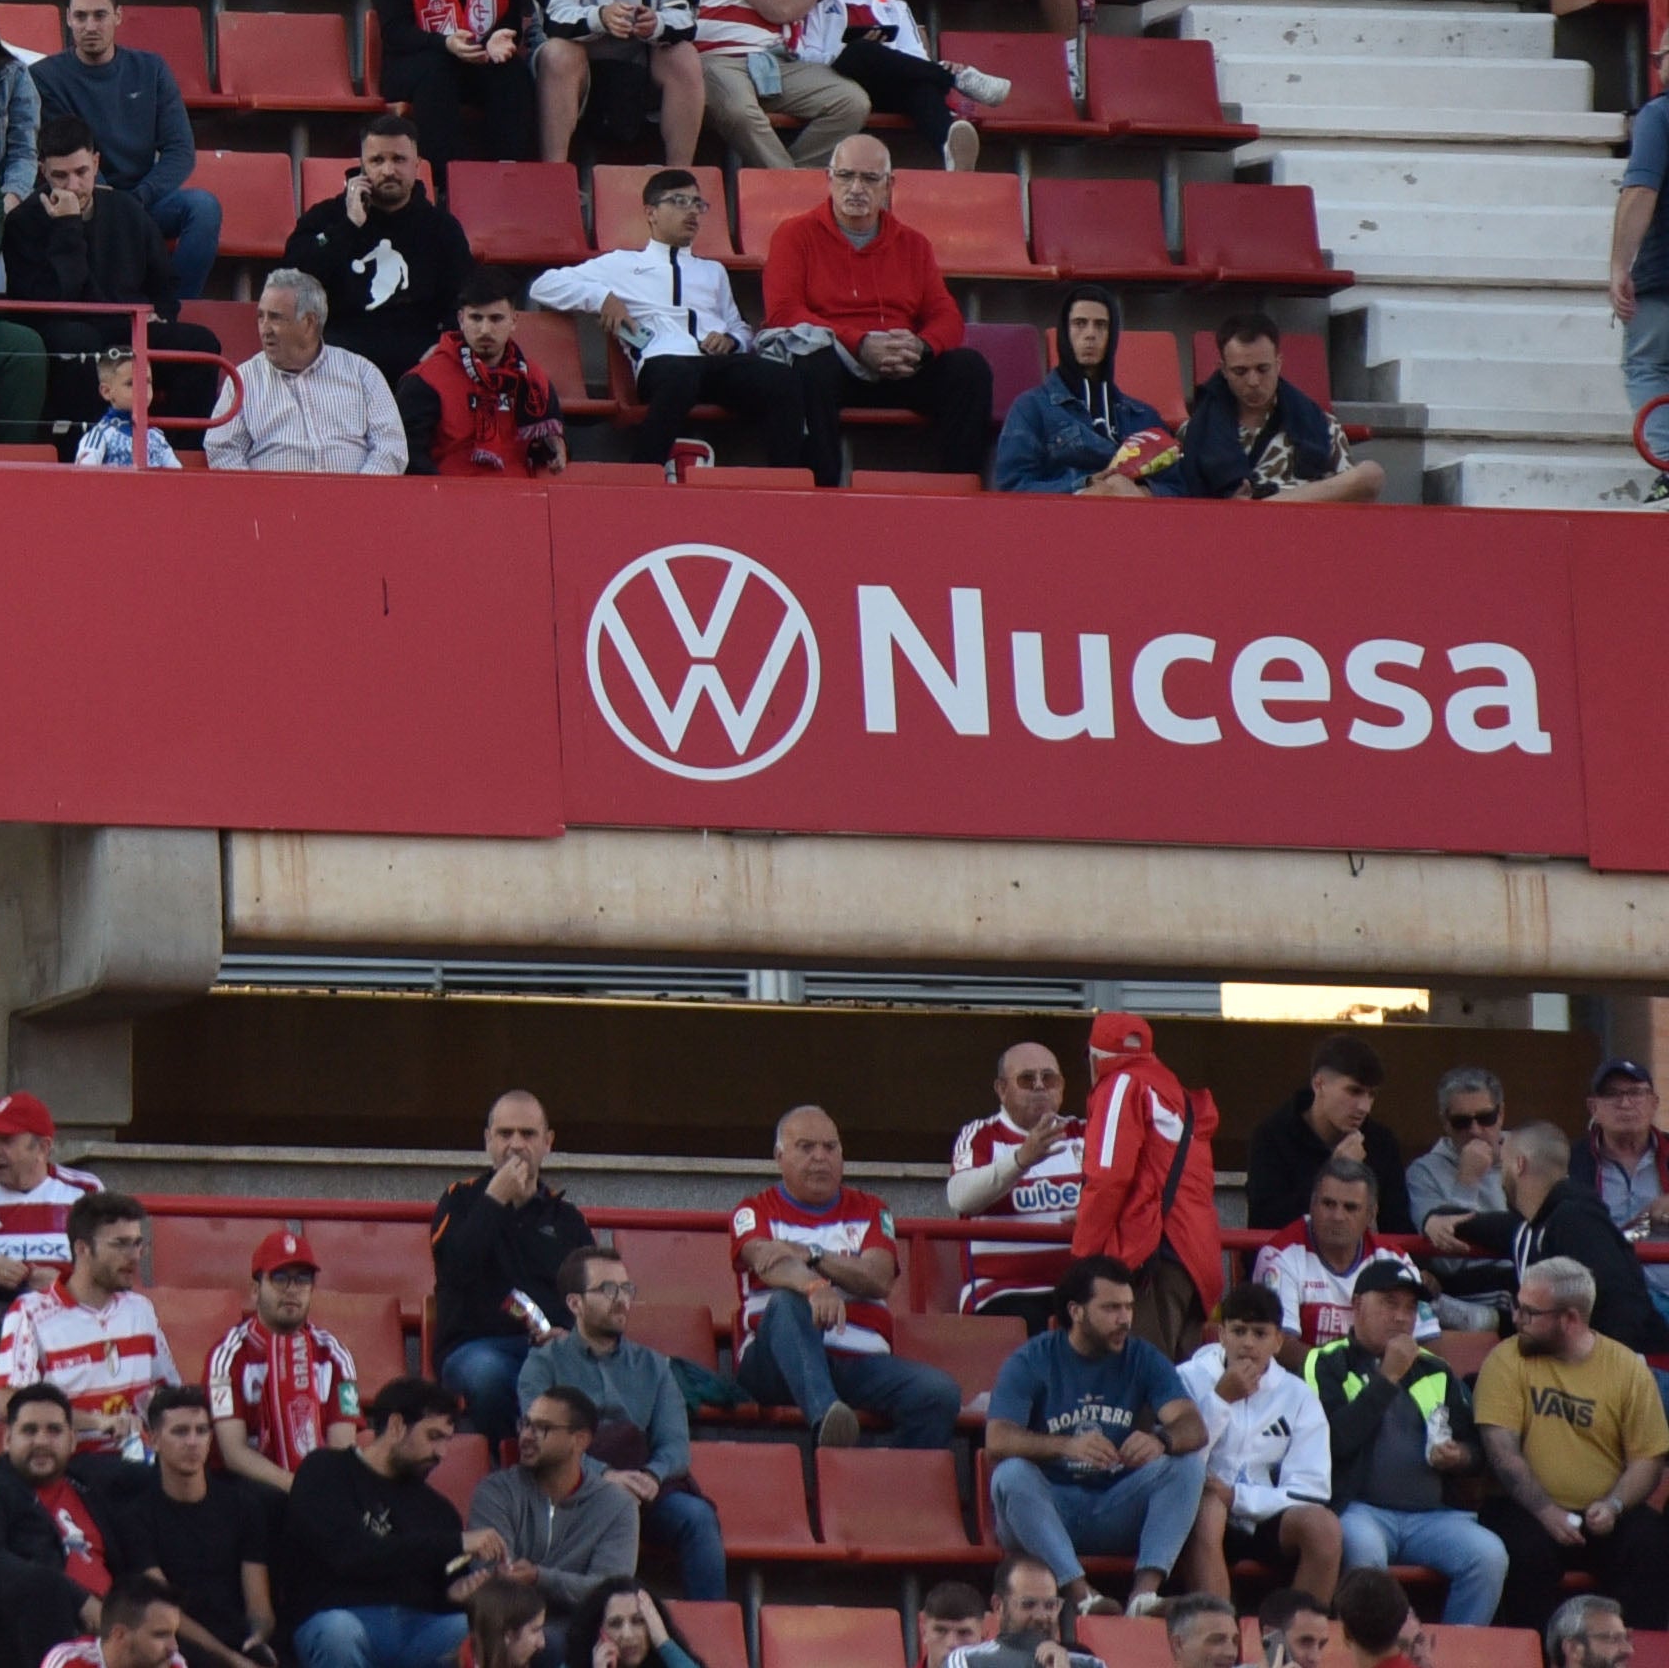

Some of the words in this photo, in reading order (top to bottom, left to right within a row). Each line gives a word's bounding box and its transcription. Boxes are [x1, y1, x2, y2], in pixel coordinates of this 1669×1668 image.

[857, 585, 1552, 756] Nucesa
[1015, 1180, 1080, 1209] wibe
[1046, 1404, 1134, 1433] ROASTERS
[1529, 1386, 1597, 1428] VANS
